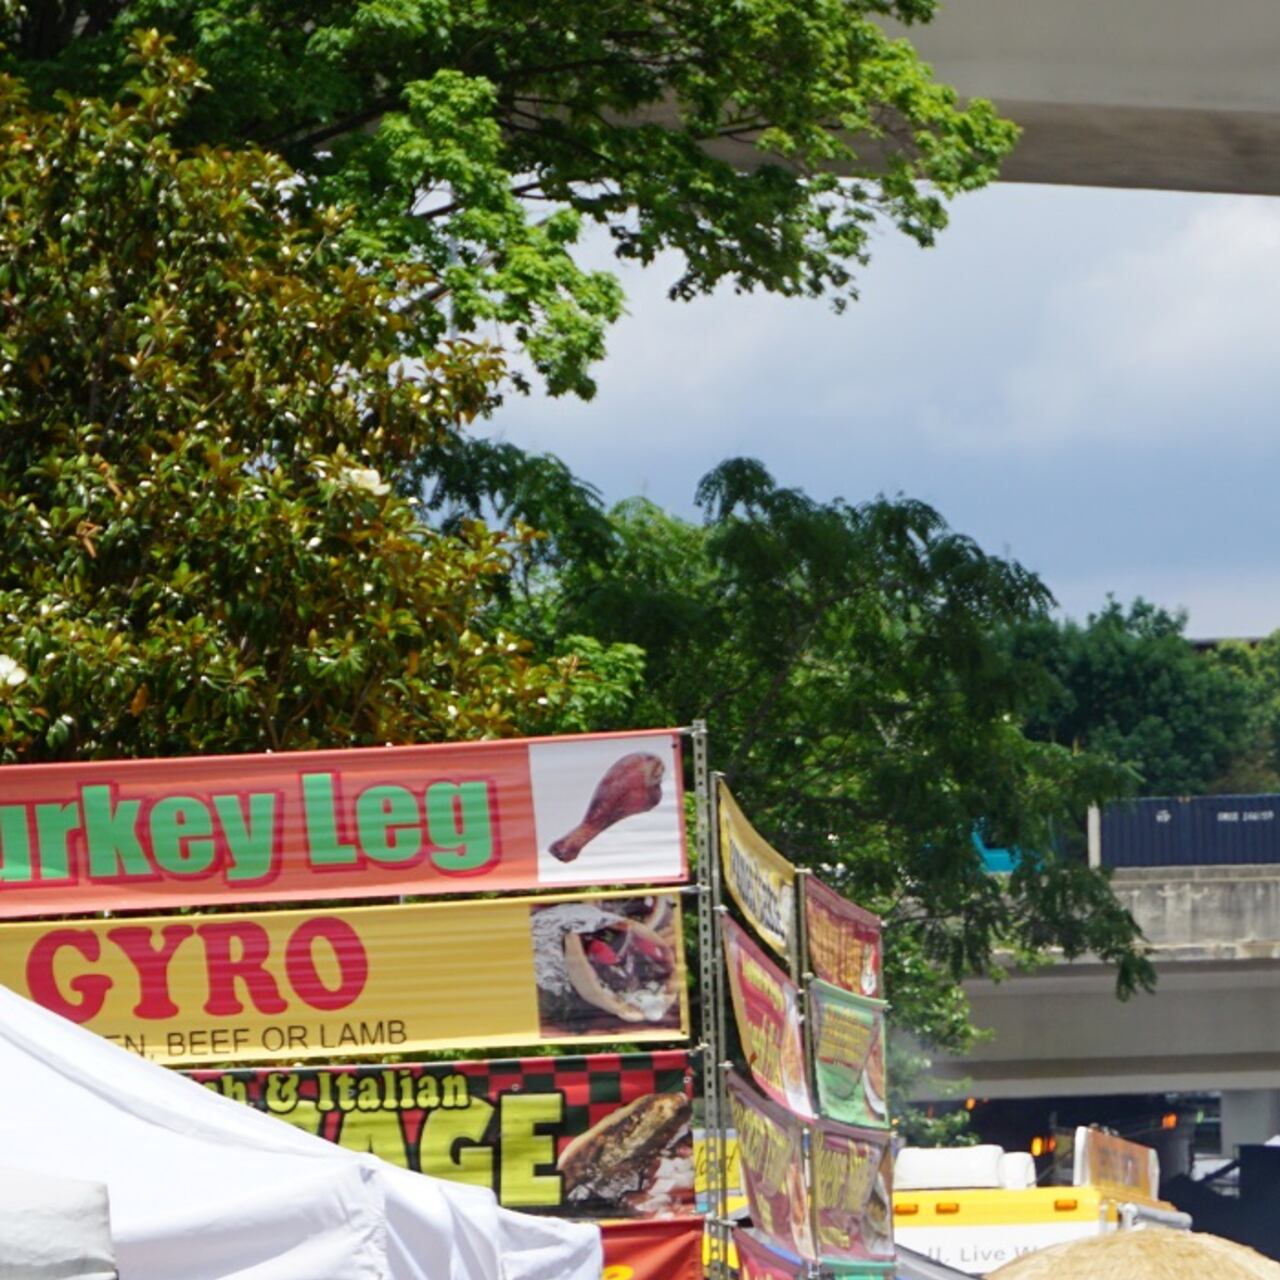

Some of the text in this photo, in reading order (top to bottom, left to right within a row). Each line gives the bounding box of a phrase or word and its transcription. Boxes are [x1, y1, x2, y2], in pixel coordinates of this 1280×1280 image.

[300, 770, 499, 878] Leg
[25, 915, 369, 1024] GYRO
[166, 1028, 250, 1058] BEEF
[260, 1024, 310, 1052] OR
[319, 1019, 408, 1050] LAMB
[314, 1069, 471, 1111] Italian
[959, 1244, 1007, 1264] Live
